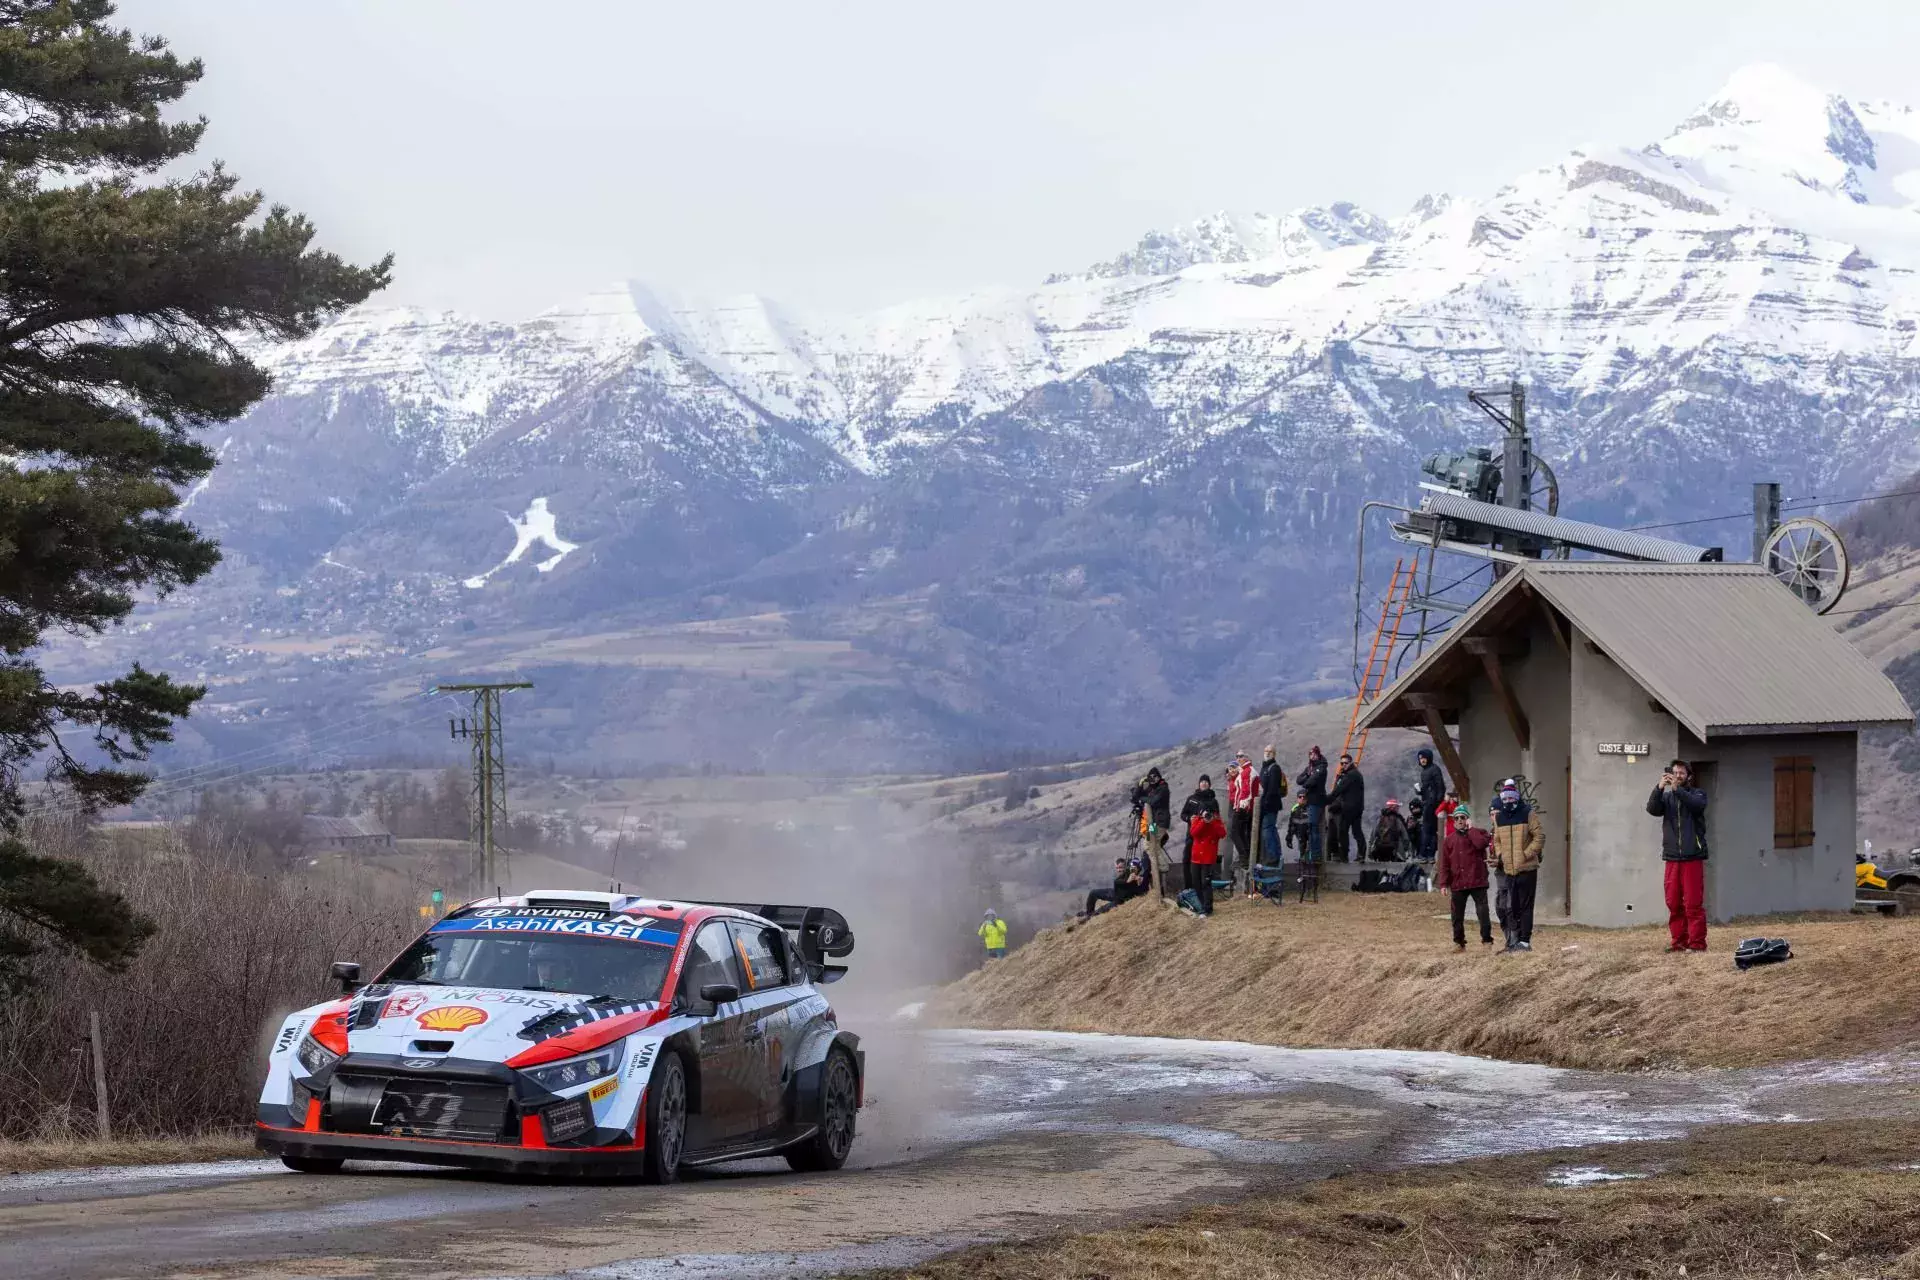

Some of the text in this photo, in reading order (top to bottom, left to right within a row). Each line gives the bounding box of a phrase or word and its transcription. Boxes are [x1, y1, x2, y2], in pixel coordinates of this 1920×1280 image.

[1599, 743, 1648, 754] COSTE BELLE
[515, 908, 606, 920] HYUNDAI
[443, 991, 556, 1009] MOBIS
[276, 1027, 296, 1053] WIA
[636, 1042, 656, 1069] WIA
